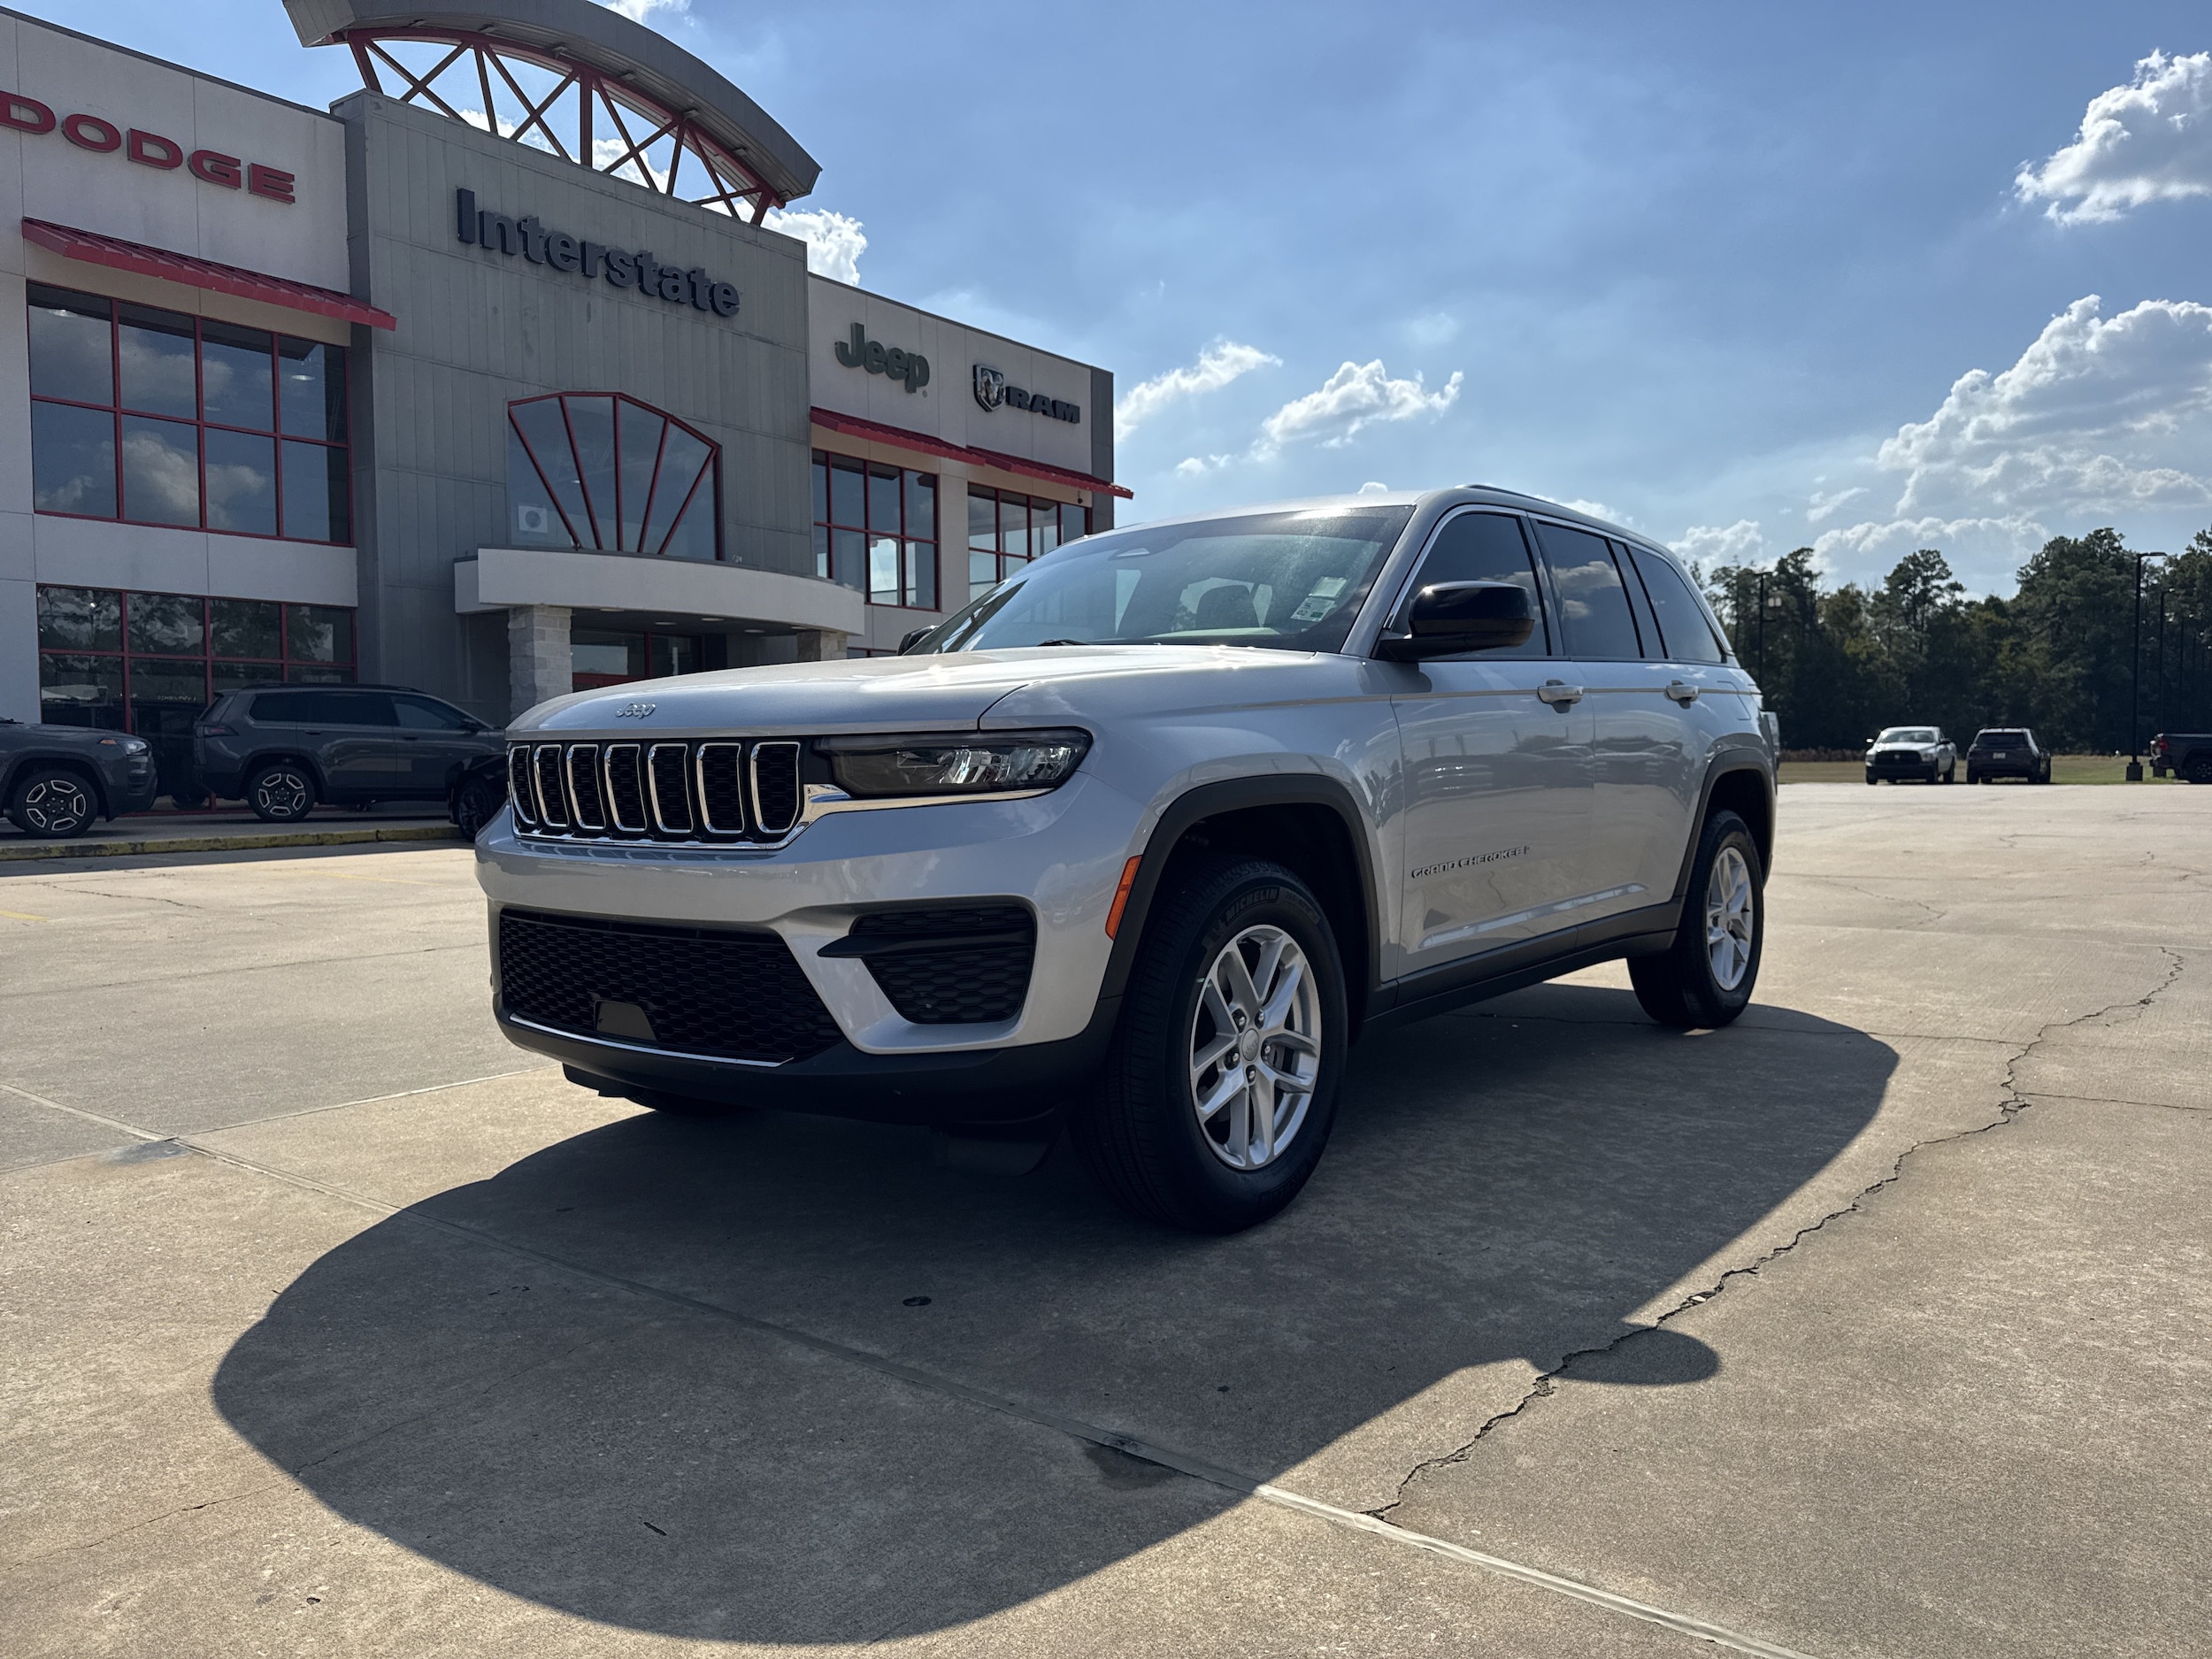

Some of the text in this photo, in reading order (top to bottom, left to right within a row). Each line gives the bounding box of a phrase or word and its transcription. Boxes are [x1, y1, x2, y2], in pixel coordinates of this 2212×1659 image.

[0, 91, 296, 204] DODGE
[457, 188, 740, 317] Interstate
[834, 322, 930, 394] Jeep
[1005, 386, 1080, 424] RAM
[615, 702, 656, 719] Jeep
[1411, 847, 1524, 878] GRAND CHEROKEE
[1225, 888, 1279, 922] MICHELIN
